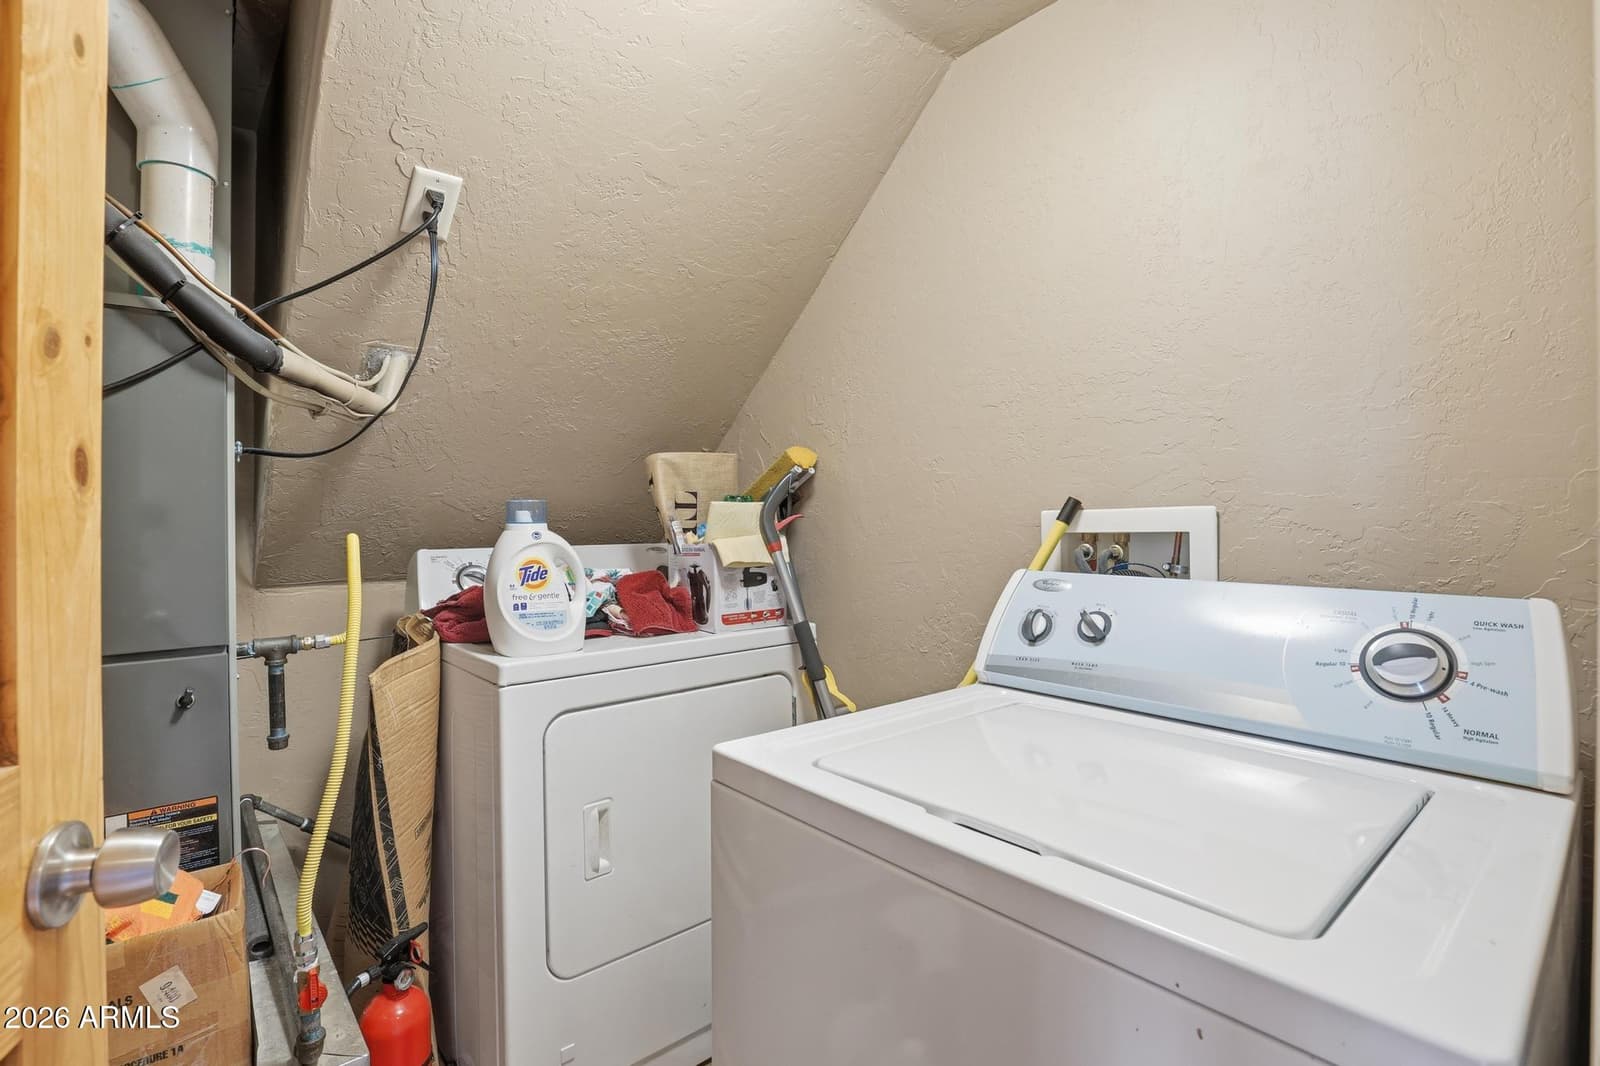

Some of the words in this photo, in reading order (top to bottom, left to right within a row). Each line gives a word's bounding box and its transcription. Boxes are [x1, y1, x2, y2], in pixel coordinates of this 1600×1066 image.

[519, 565, 548, 587] Tide
[512, 593, 528, 601] free
[537, 592, 560, 601] gentle
[1473, 620, 1498, 628] QUICK
[1500, 622, 1525, 630] WASH
[1476, 683, 1509, 697] Pre-wash
[1428, 718, 1441, 740] Regular
[1463, 728, 1499, 740] NORMAL
[159, 802, 196, 813] WARNING
[171, 1045, 184, 1056] 1A
